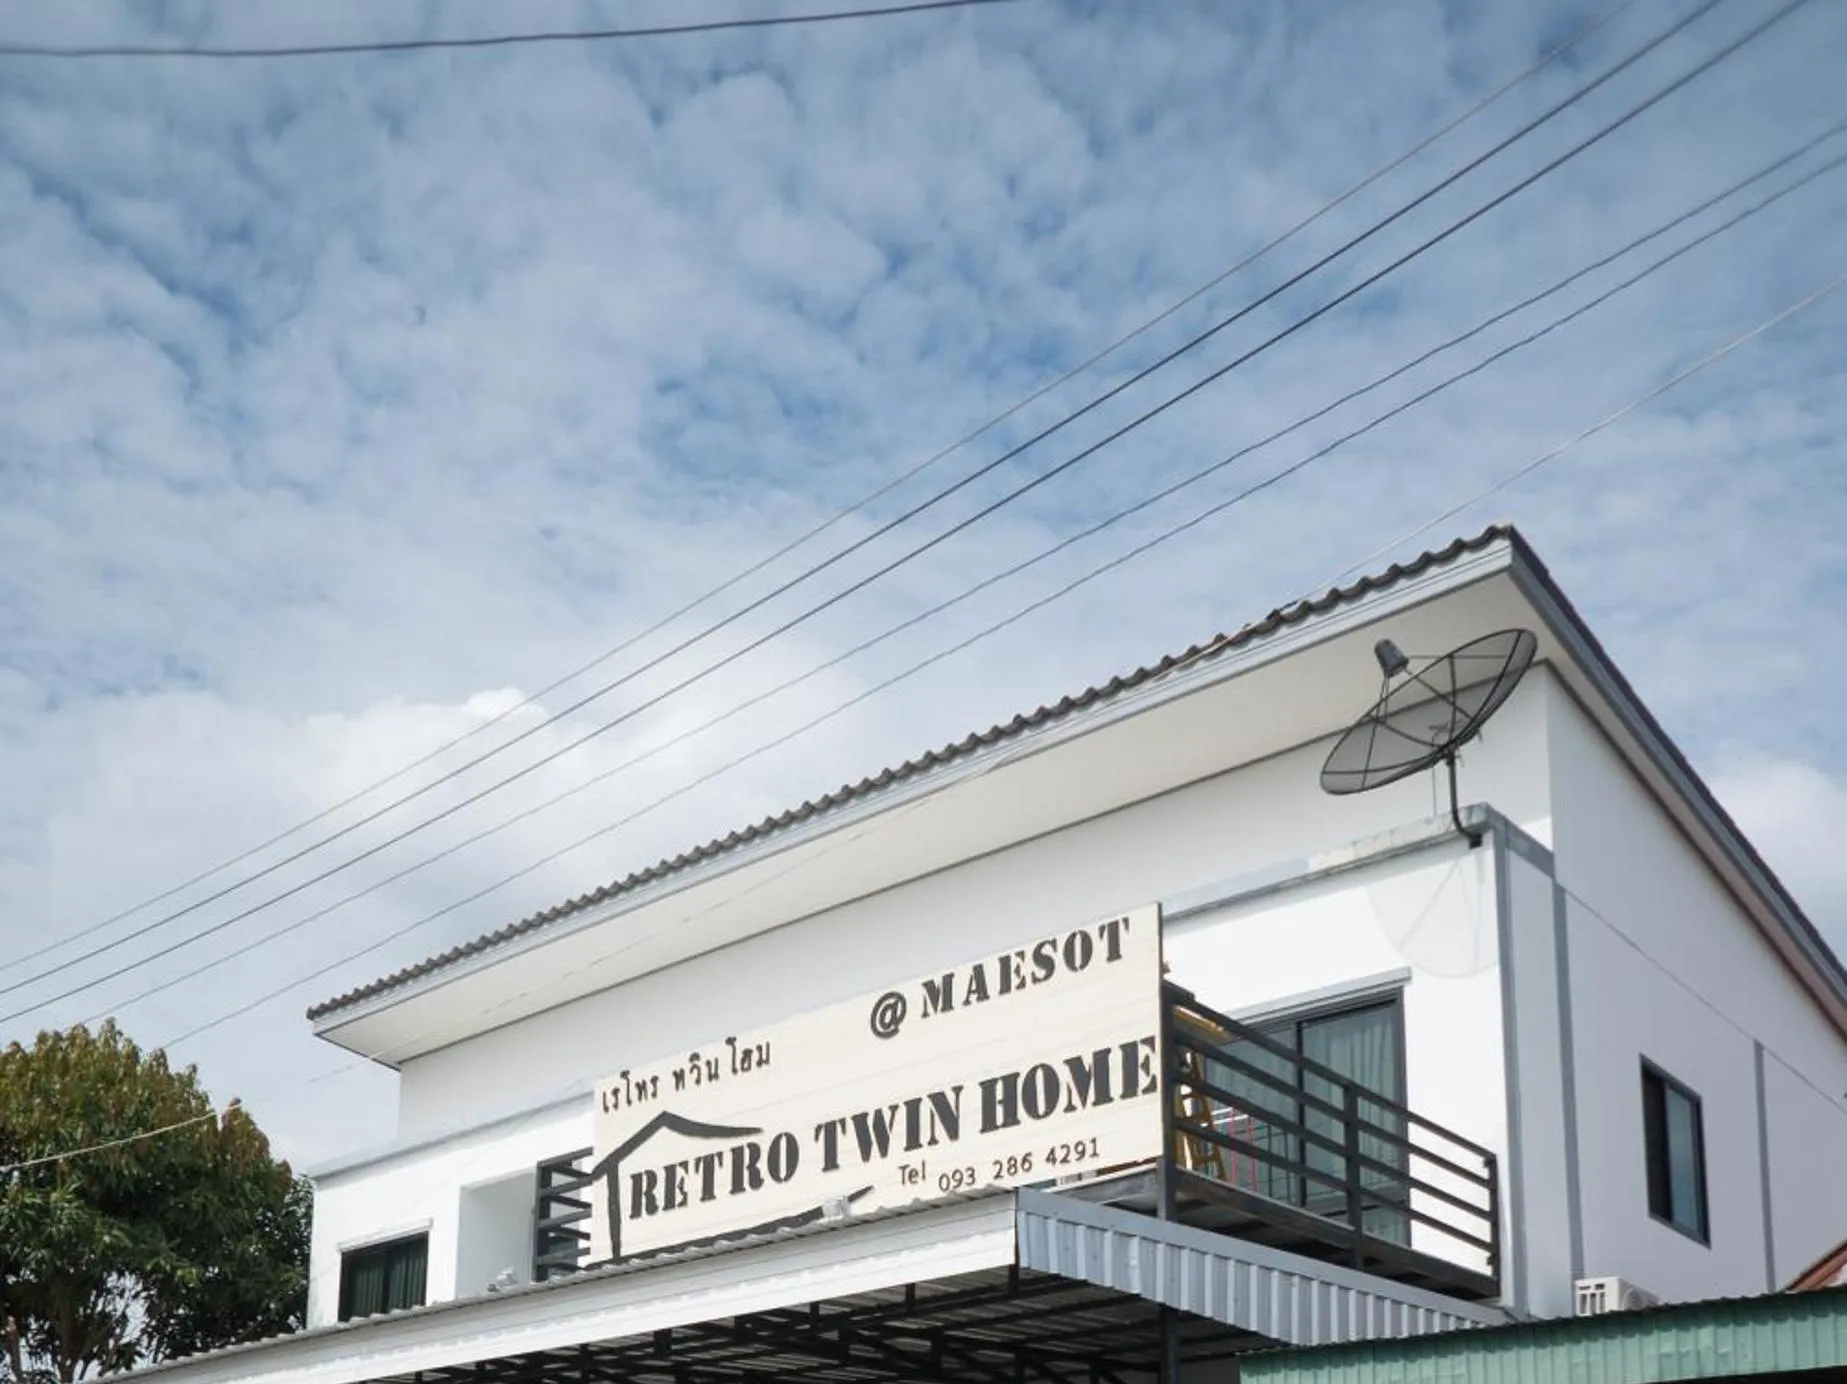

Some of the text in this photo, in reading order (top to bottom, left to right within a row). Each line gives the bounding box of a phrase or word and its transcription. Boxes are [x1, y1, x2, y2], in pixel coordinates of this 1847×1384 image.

[870, 916, 1131, 1039] @ MAESOT
[602, 1036, 771, 1114] เรโทร ทวิน โฮม
[628, 1035, 1159, 1220] RETRO TWIN HOME
[898, 1137, 1101, 1192] Tel 093 286 4291
